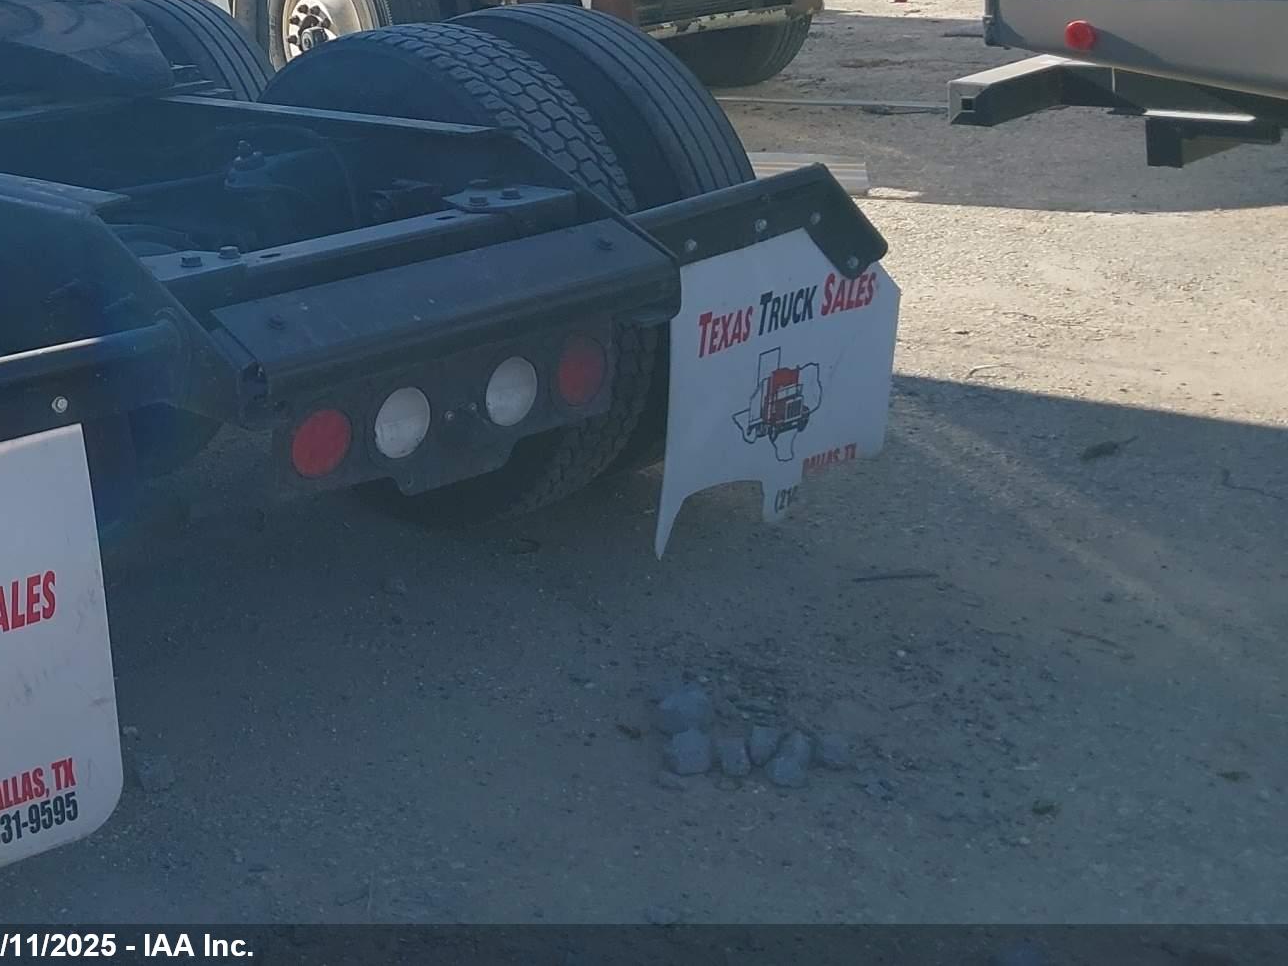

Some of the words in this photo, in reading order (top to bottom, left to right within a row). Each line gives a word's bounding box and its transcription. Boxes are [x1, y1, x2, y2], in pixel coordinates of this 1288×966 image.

[698, 305, 754, 359] TEXAS
[758, 284, 819, 336] TRUCK
[820, 271, 878, 317] SALES
[51, 757, 77, 790] TX
